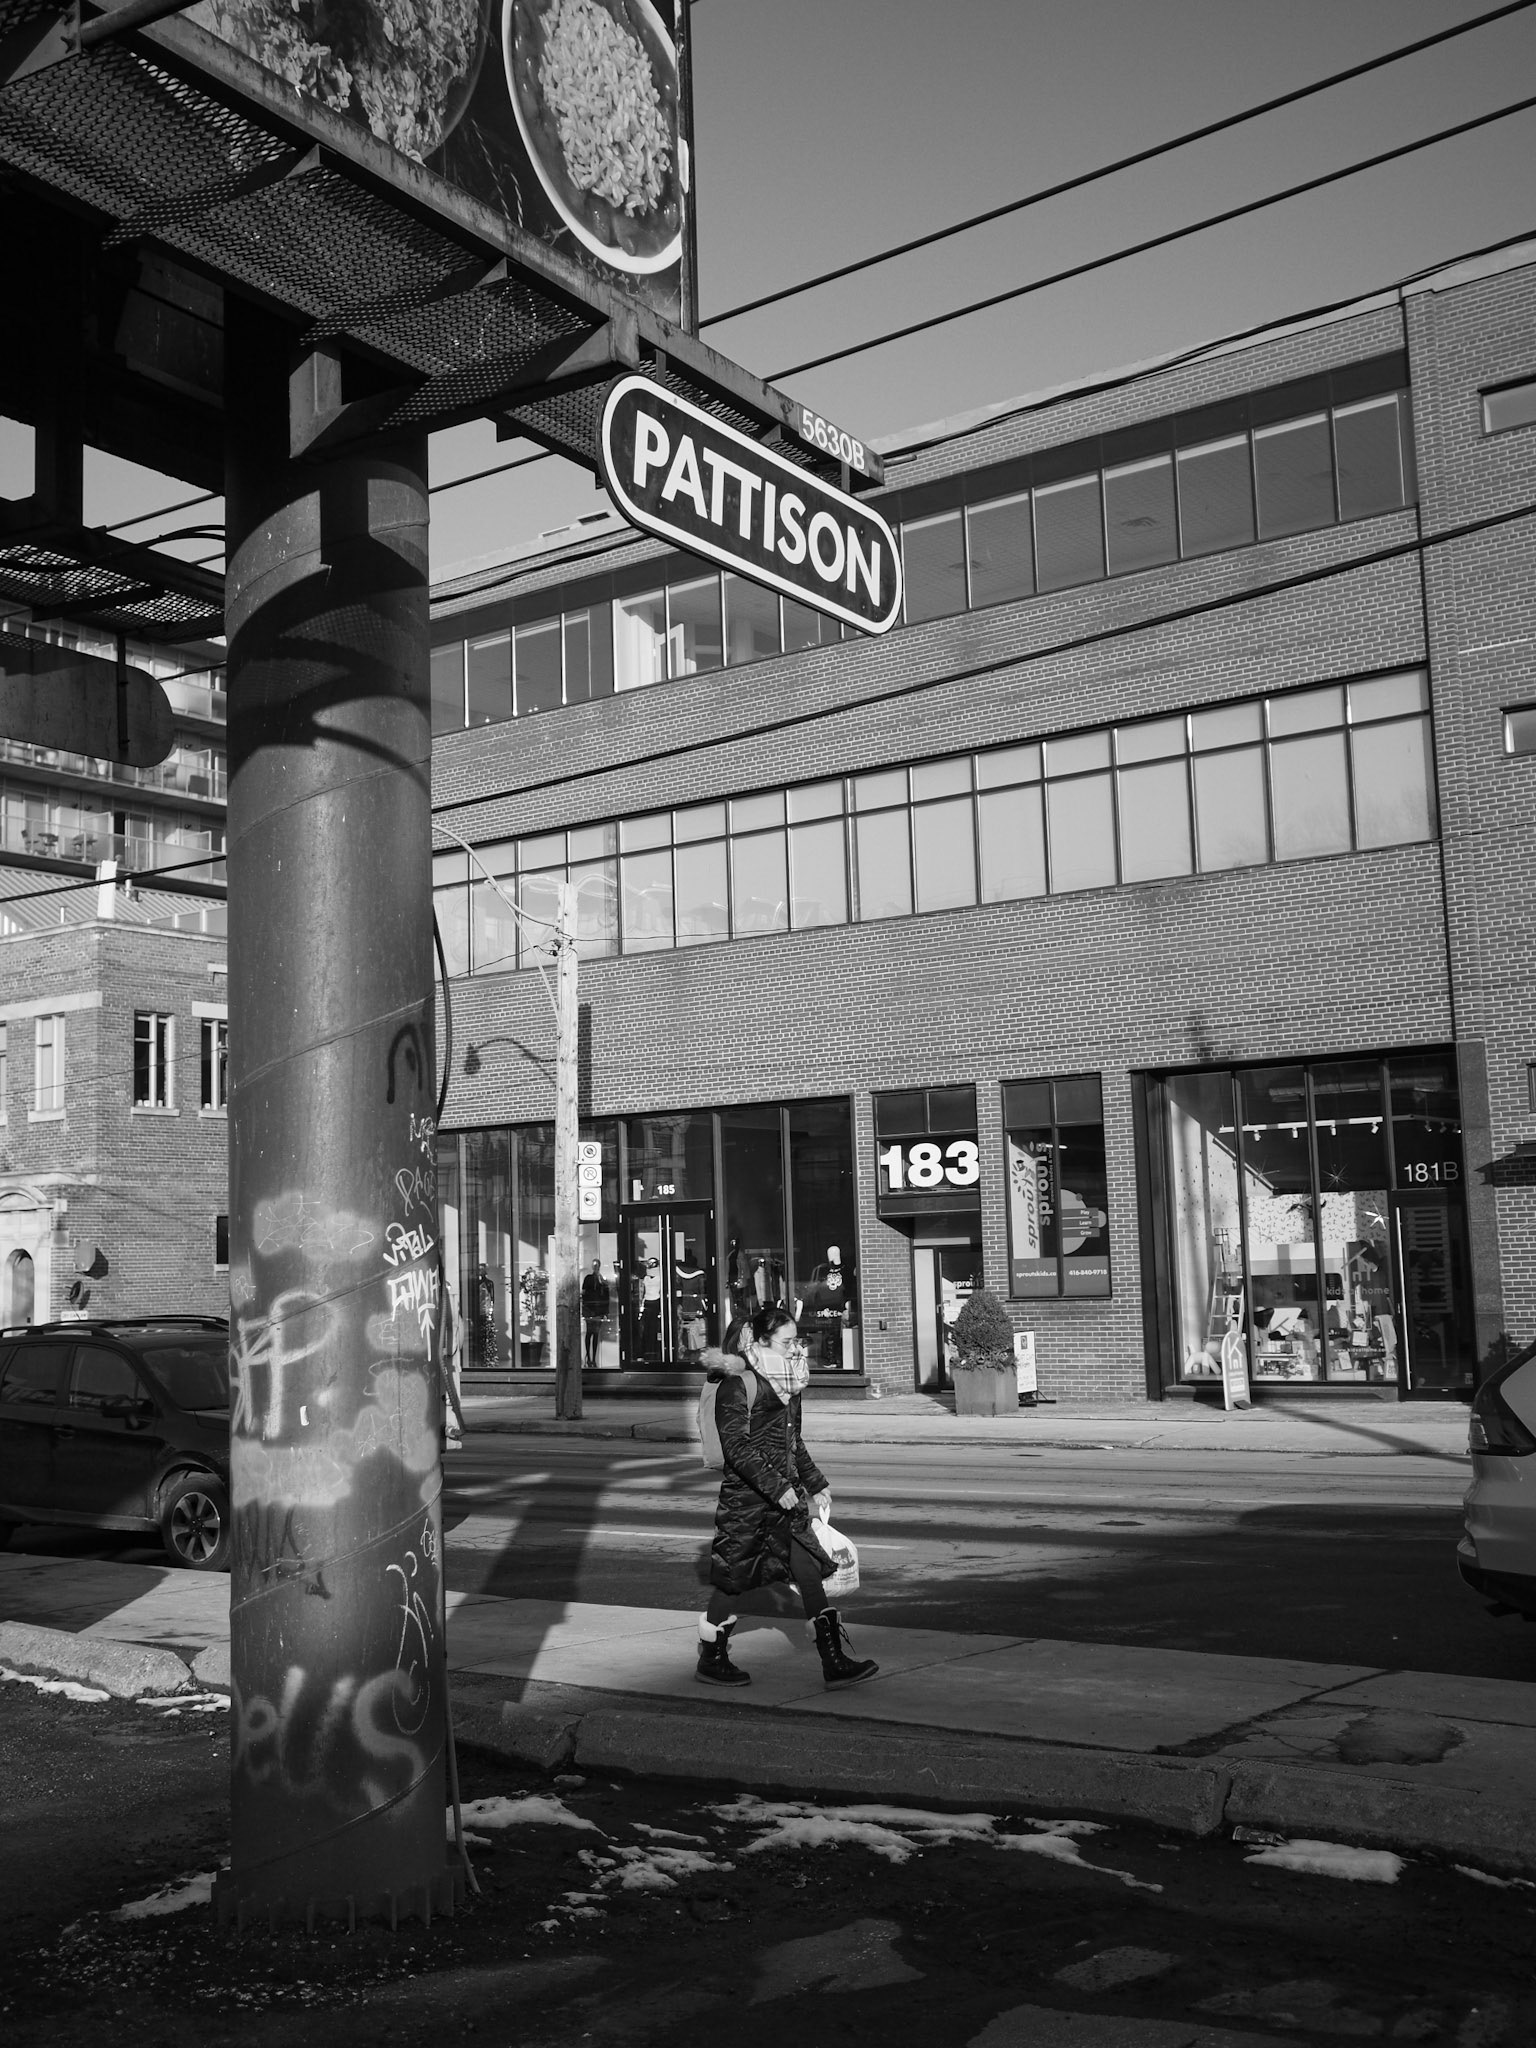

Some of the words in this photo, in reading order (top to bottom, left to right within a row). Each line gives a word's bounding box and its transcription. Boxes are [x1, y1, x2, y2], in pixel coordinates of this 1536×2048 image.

[802, 409, 865, 471] 5630B
[633, 410, 881, 607] PATTISON
[880, 1140, 980, 1189] 183
[1404, 1162, 1459, 1182] 181B
[657, 1184, 675, 1195] 185
[1361, 1287, 1390, 1295] home
